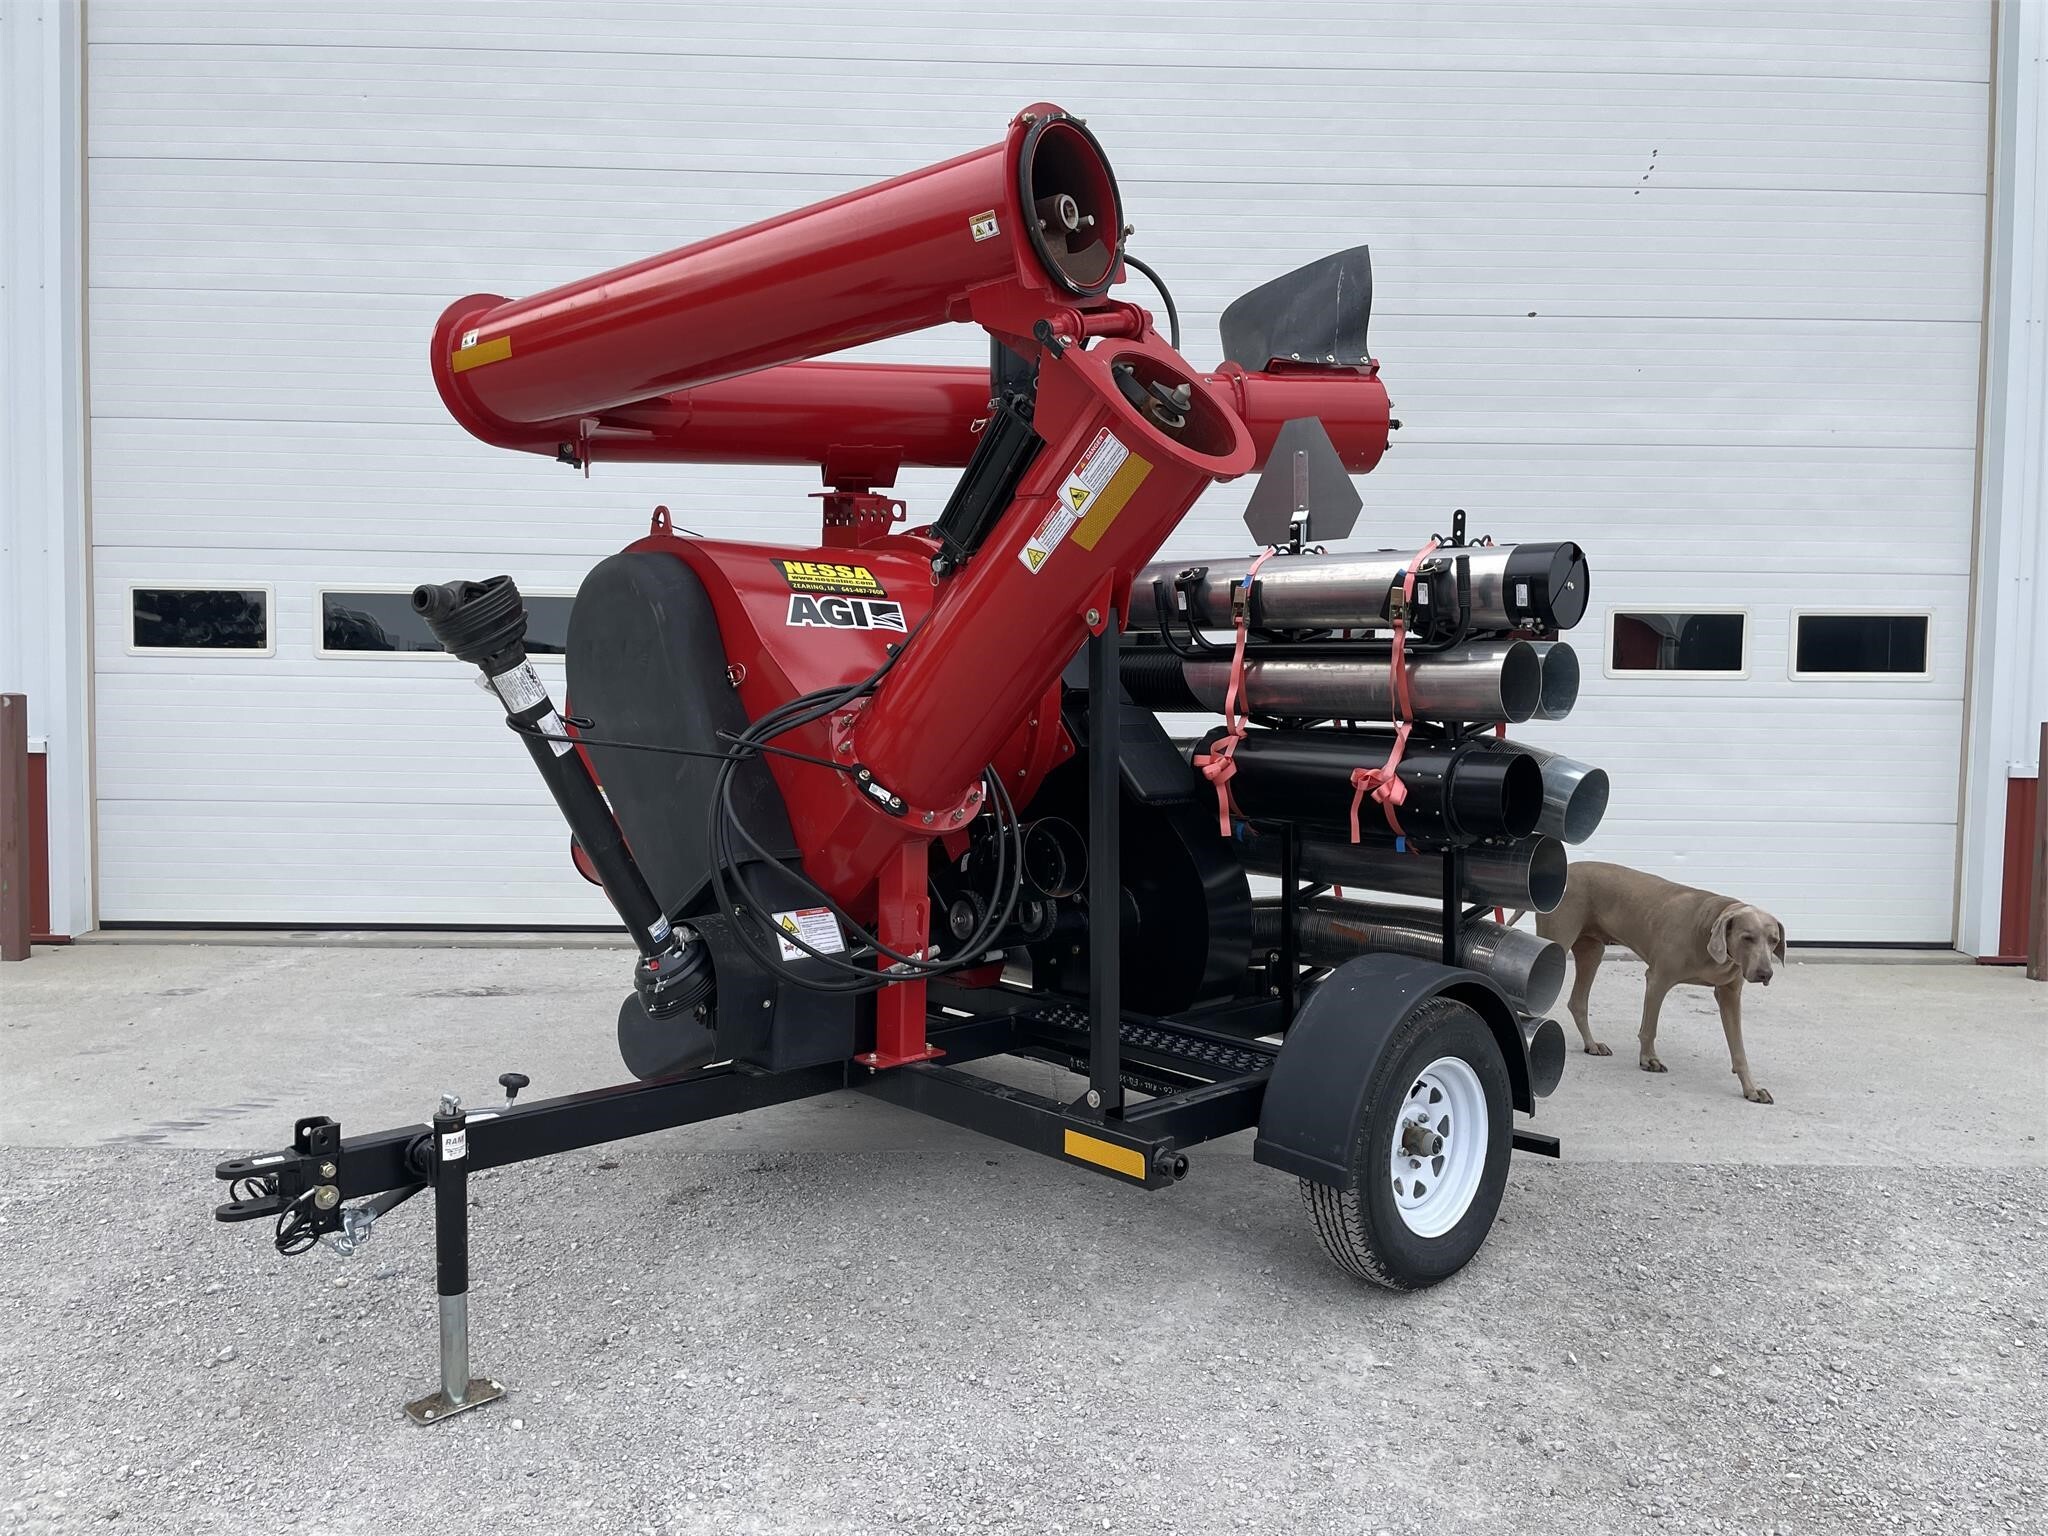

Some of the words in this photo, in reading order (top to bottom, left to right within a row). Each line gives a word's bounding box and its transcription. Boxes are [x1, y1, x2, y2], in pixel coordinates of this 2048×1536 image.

[1085, 435, 1104, 460] DANGER
[782, 560, 874, 580] NESSA
[789, 596, 869, 627] AGI
[445, 1135, 465, 1146] RAM
